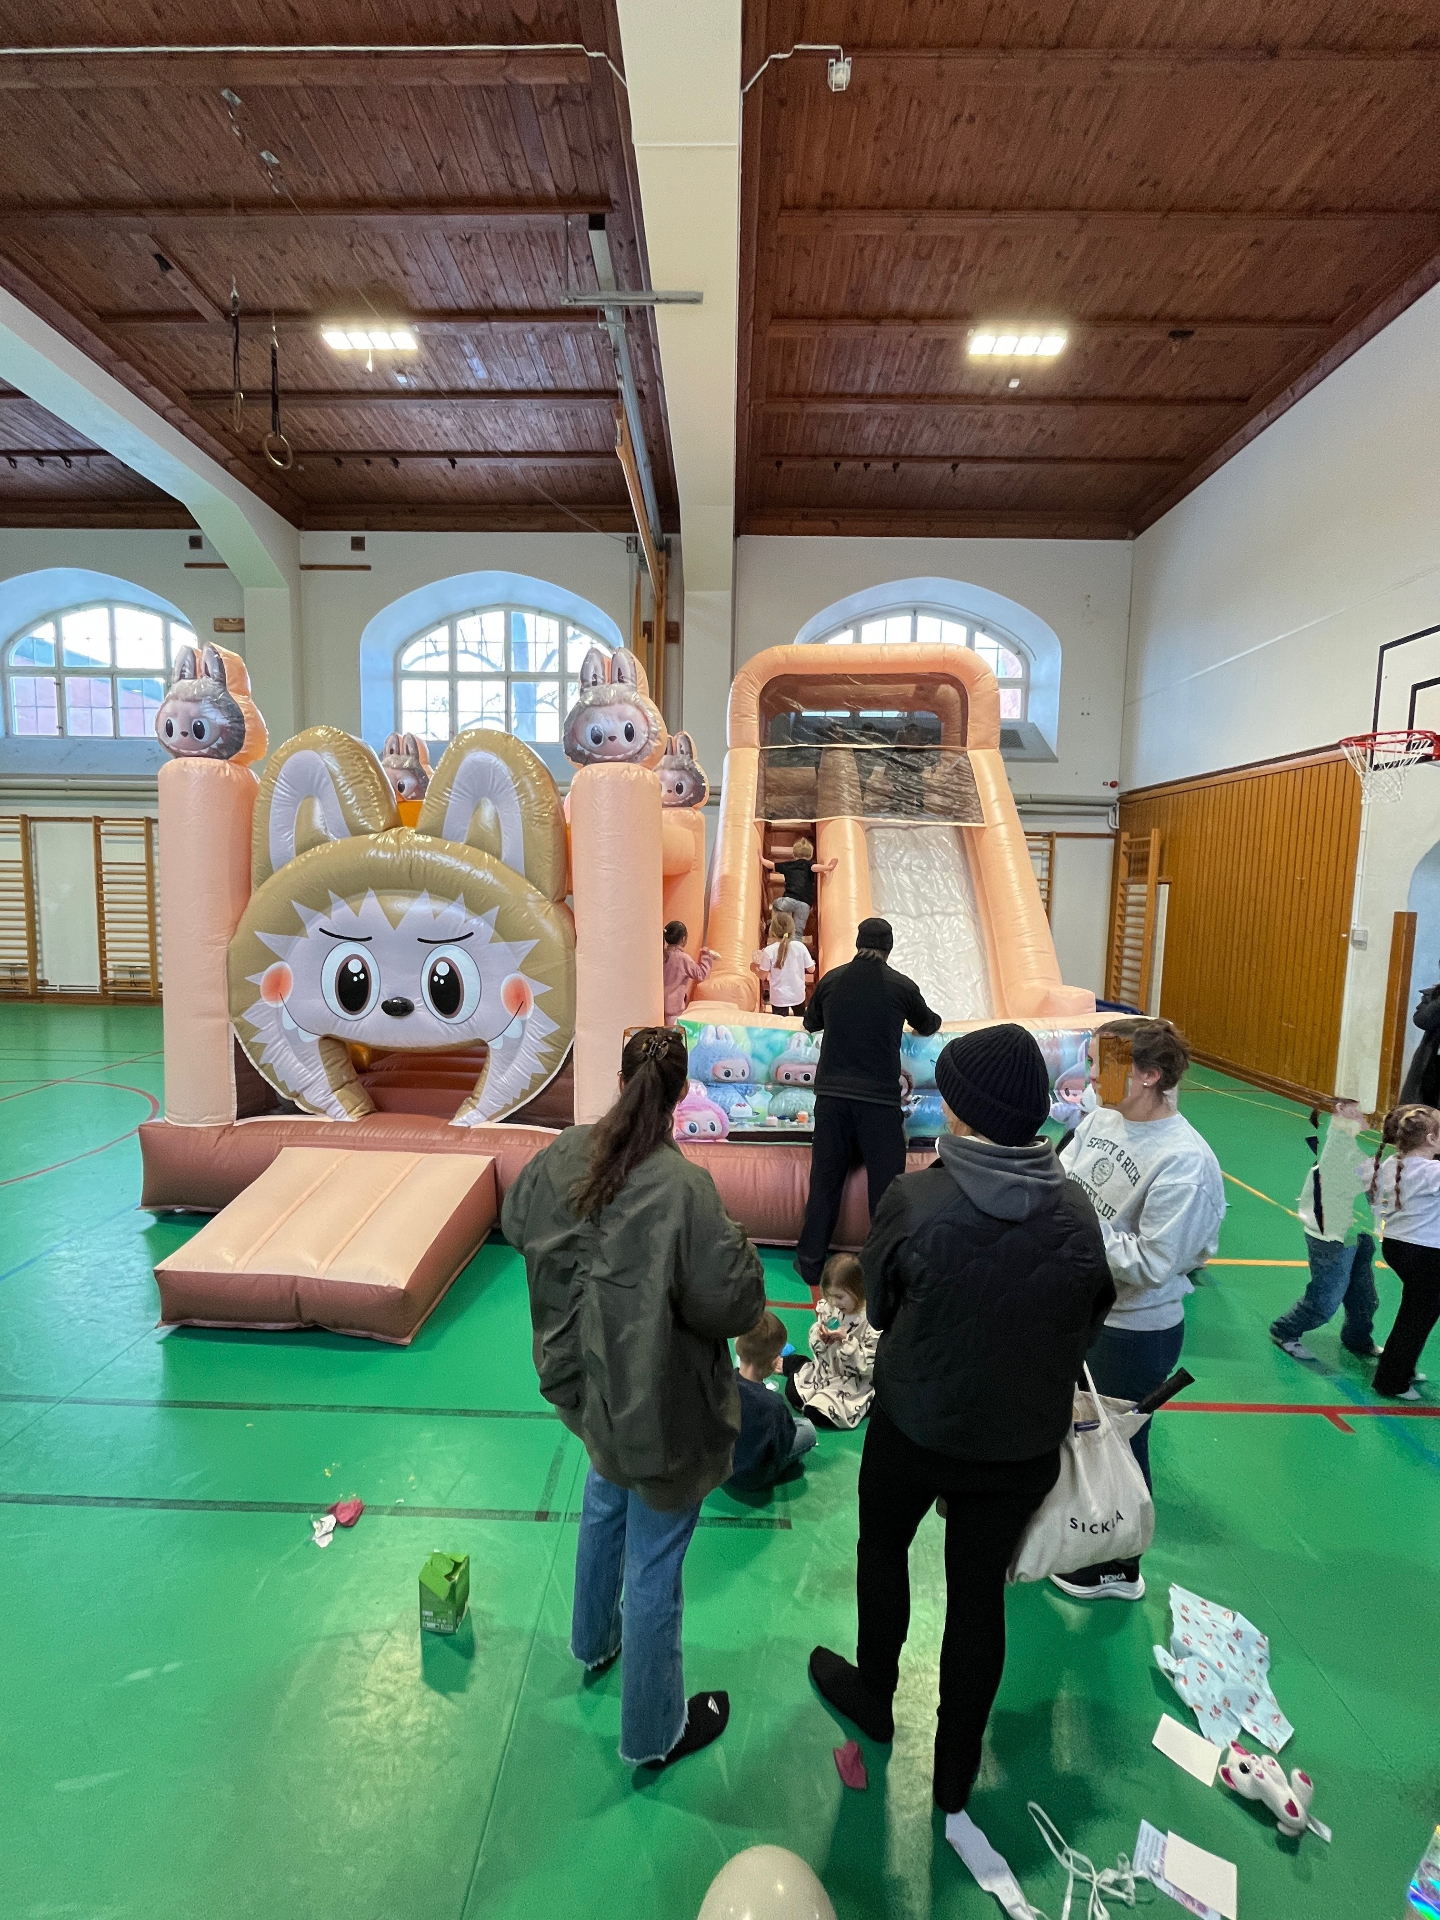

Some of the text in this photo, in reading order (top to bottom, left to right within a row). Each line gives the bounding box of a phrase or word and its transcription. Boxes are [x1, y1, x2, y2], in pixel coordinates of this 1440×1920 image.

[1087, 1137, 1141, 1187] SPORTY & RICH
[1100, 1572, 1127, 1584] HOKA
